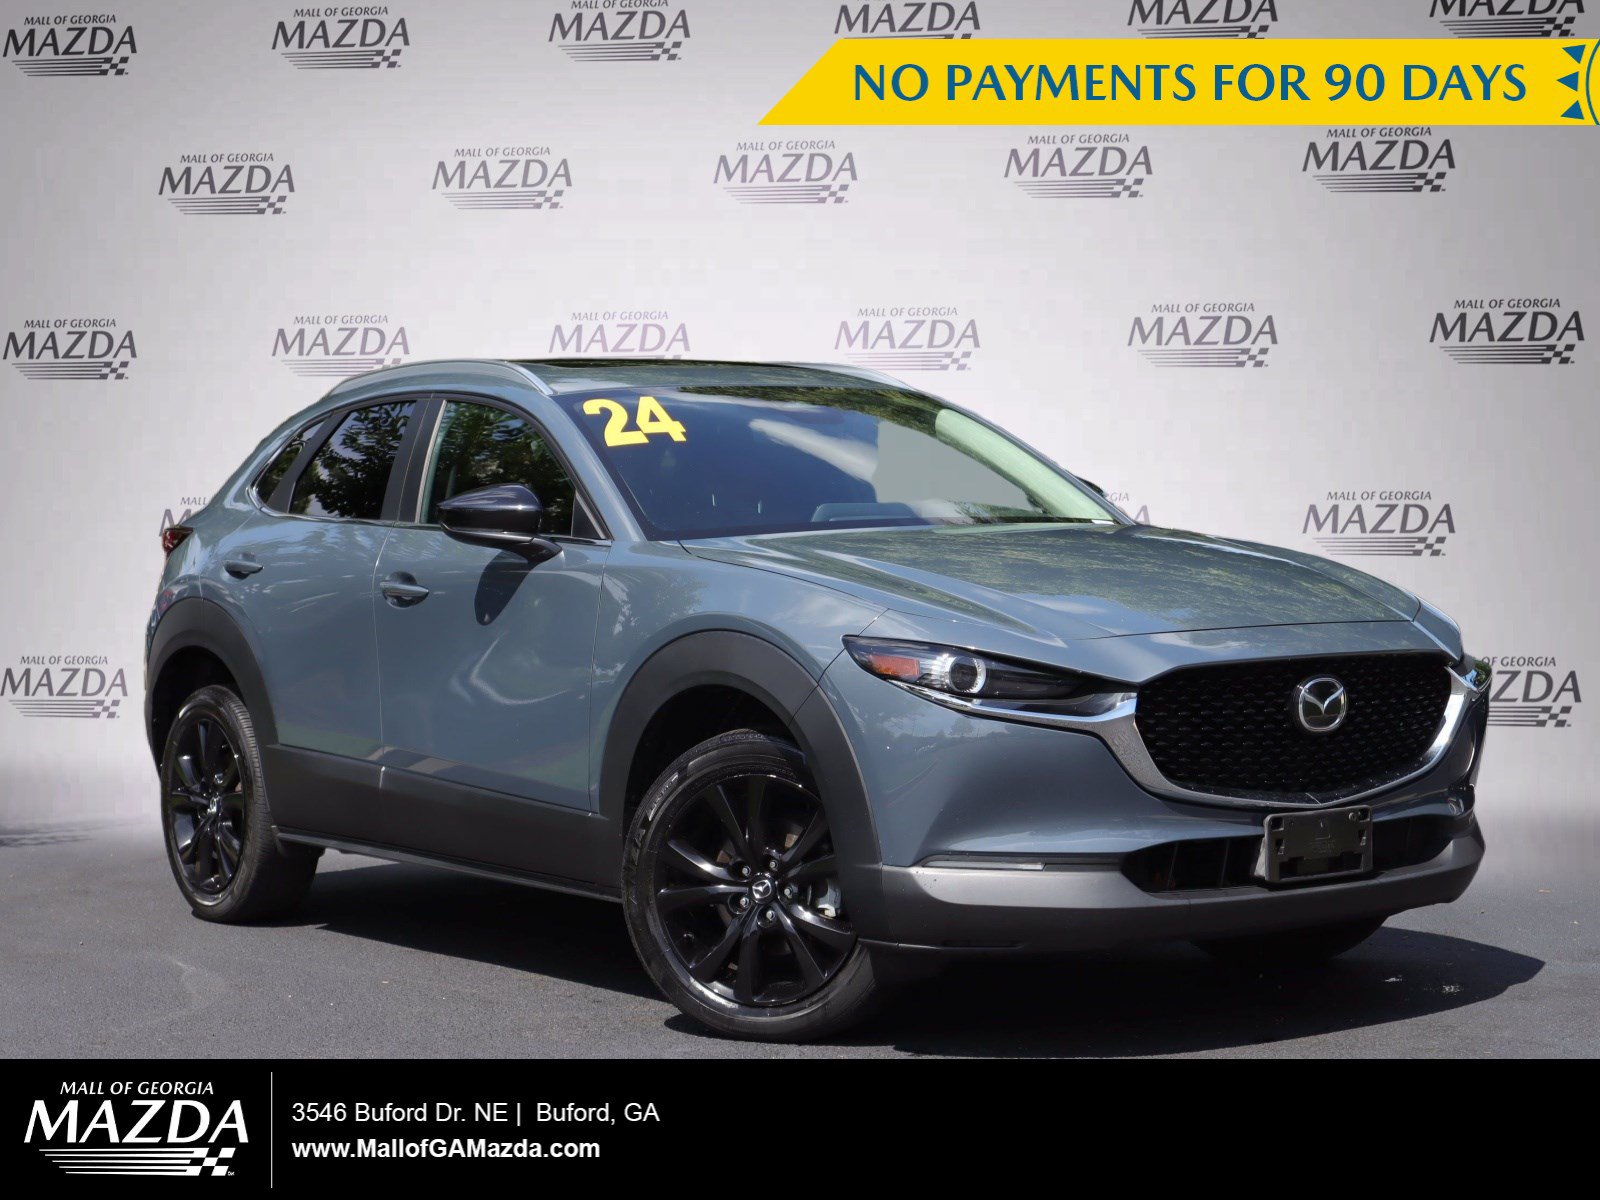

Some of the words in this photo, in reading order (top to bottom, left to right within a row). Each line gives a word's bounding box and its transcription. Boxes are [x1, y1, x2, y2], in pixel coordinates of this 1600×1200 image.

[293, 8, 321, 18] MALL
[324, 7, 338, 17] OF
[341, 6, 388, 17] GEORGIA
[571, 0, 599, 9] MALL
[603, 0, 617, 8] OF
[834, 1, 980, 34] MAZDA
[1127, 0, 1278, 26] MAZDA
[24, 16, 51, 25] MALL
[54, 15, 67, 25] OF
[70, 14, 116, 25] GEORGIA
[271, 17, 410, 49] MAZDA
[548, 9, 690, 42] MAZDA
[2, 26, 137, 57] MAZDA
[736, 142, 765, 152] MALL
[768, 141, 782, 151] OF
[786, 140, 835, 151] GEORGIA
[1028, 135, 1058, 145] MALL
[1061, 134, 1075, 145] OF
[1078, 133, 1129, 145] GEORGIA
[1326, 128, 1357, 139] MALL
[1361, 127, 1376, 138] OF
[1380, 127, 1431, 138] GEORGIA
[180, 154, 207, 163] MALL
[210, 153, 223, 163] OF
[226, 153, 274, 163] GEORGIA
[454, 148, 482, 158] MALL
[486, 147, 500, 157] OF
[503, 146, 550, 157] GEORGIA
[1004, 145, 1153, 178] MAZDA
[1302, 139, 1456, 173] MAZDA
[158, 165, 295, 196] MAZDA
[432, 158, 572, 190] MAZDA
[714, 152, 858, 183] MAZDA
[571, 312, 599, 322] MALL
[603, 311, 617, 321] OF
[620, 311, 668, 321] GEORGIA
[858, 308, 887, 318] MALL
[890, 307, 904, 317] OF
[908, 307, 957, 317] GEORGIA
[1152, 304, 1182, 314] MALL
[1185, 303, 1200, 314] OF
[1203, 303, 1255, 314] GEORGIA
[1454, 299, 1485, 310] MALL
[1488, 298, 1503, 309] OF
[1507, 298, 1560, 309] GEORGIA
[24, 320, 51, 329] MALL
[54, 319, 67, 329] OF
[70, 318, 116, 329] GEORGIA
[294, 316, 322, 325] MALL
[325, 315, 339, 325] OF
[342, 315, 388, 325] GEORGIA
[835, 319, 980, 349] MAZDA
[1128, 315, 1278, 346] MAZDA
[1429, 310, 1585, 344] MAZDA
[2, 331, 137, 360] MAZDA
[272, 327, 410, 357] MAZDA
[549, 323, 690, 353] MAZDA
[583, 396, 686, 447] 24
[1327, 491, 1358, 502] MALL
[1361, 490, 1376, 501] OF
[1379, 490, 1432, 501] GEORGIA
[1302, 503, 1456, 535] MAZDA
[20, 656, 46, 665] MALL
[49, 655, 62, 664] OF
[65, 655, 108, 664] GEORGIA
[1500, 656, 1556, 667] GEORGIA
[0, 667, 128, 697] MAZDA
[1490, 670, 1582, 703] ZDA
